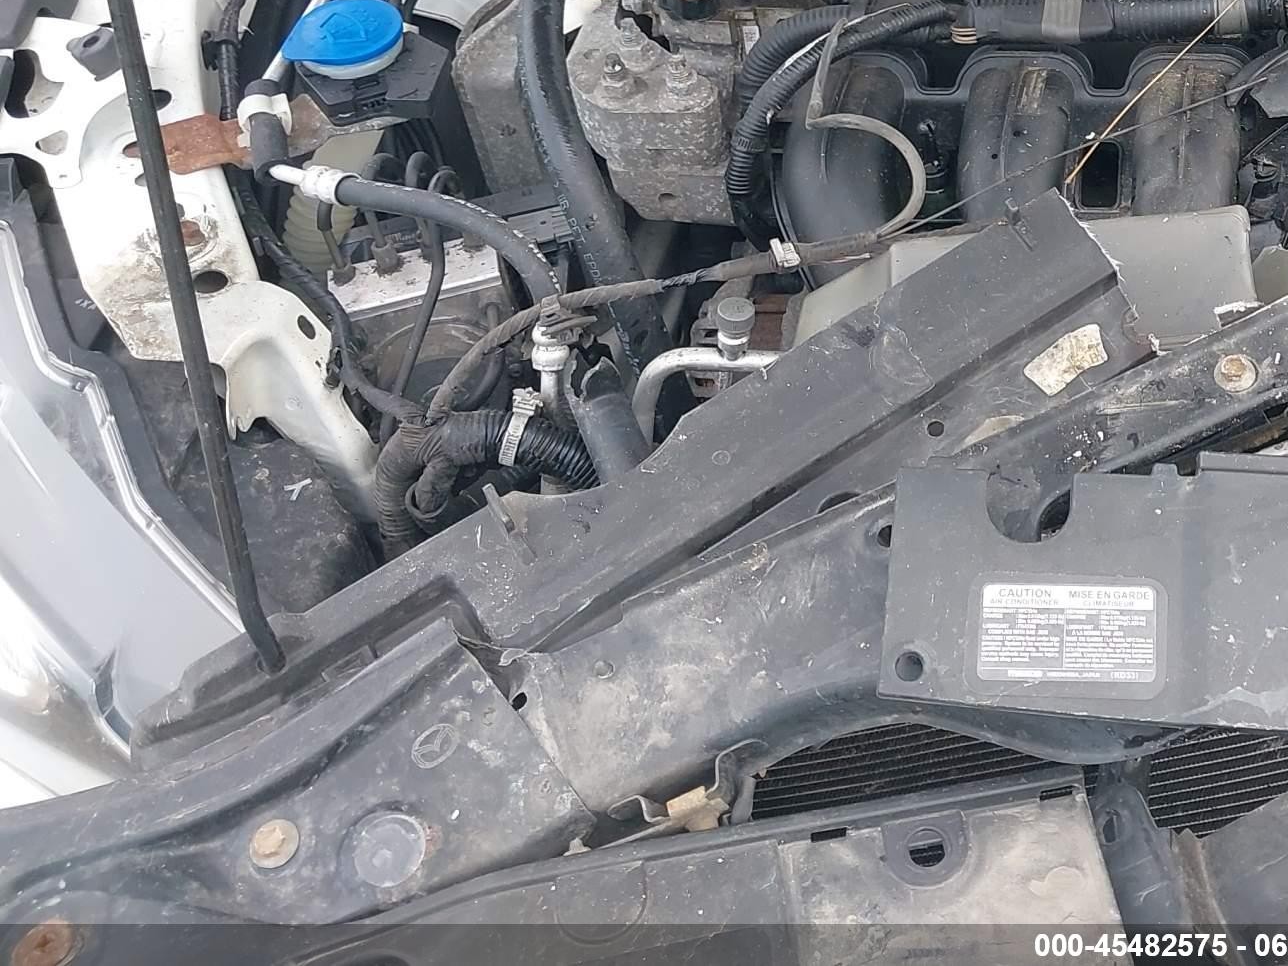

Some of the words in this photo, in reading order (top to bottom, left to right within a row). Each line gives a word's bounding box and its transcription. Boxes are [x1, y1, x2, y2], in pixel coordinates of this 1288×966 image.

[998, 588, 1052, 598] CAUTION
[1068, 590, 1094, 599] MISE
[1096, 590, 1111, 600] EN
[1113, 591, 1151, 601] GARDE
[1005, 598, 1060, 607] CONDITIONER
